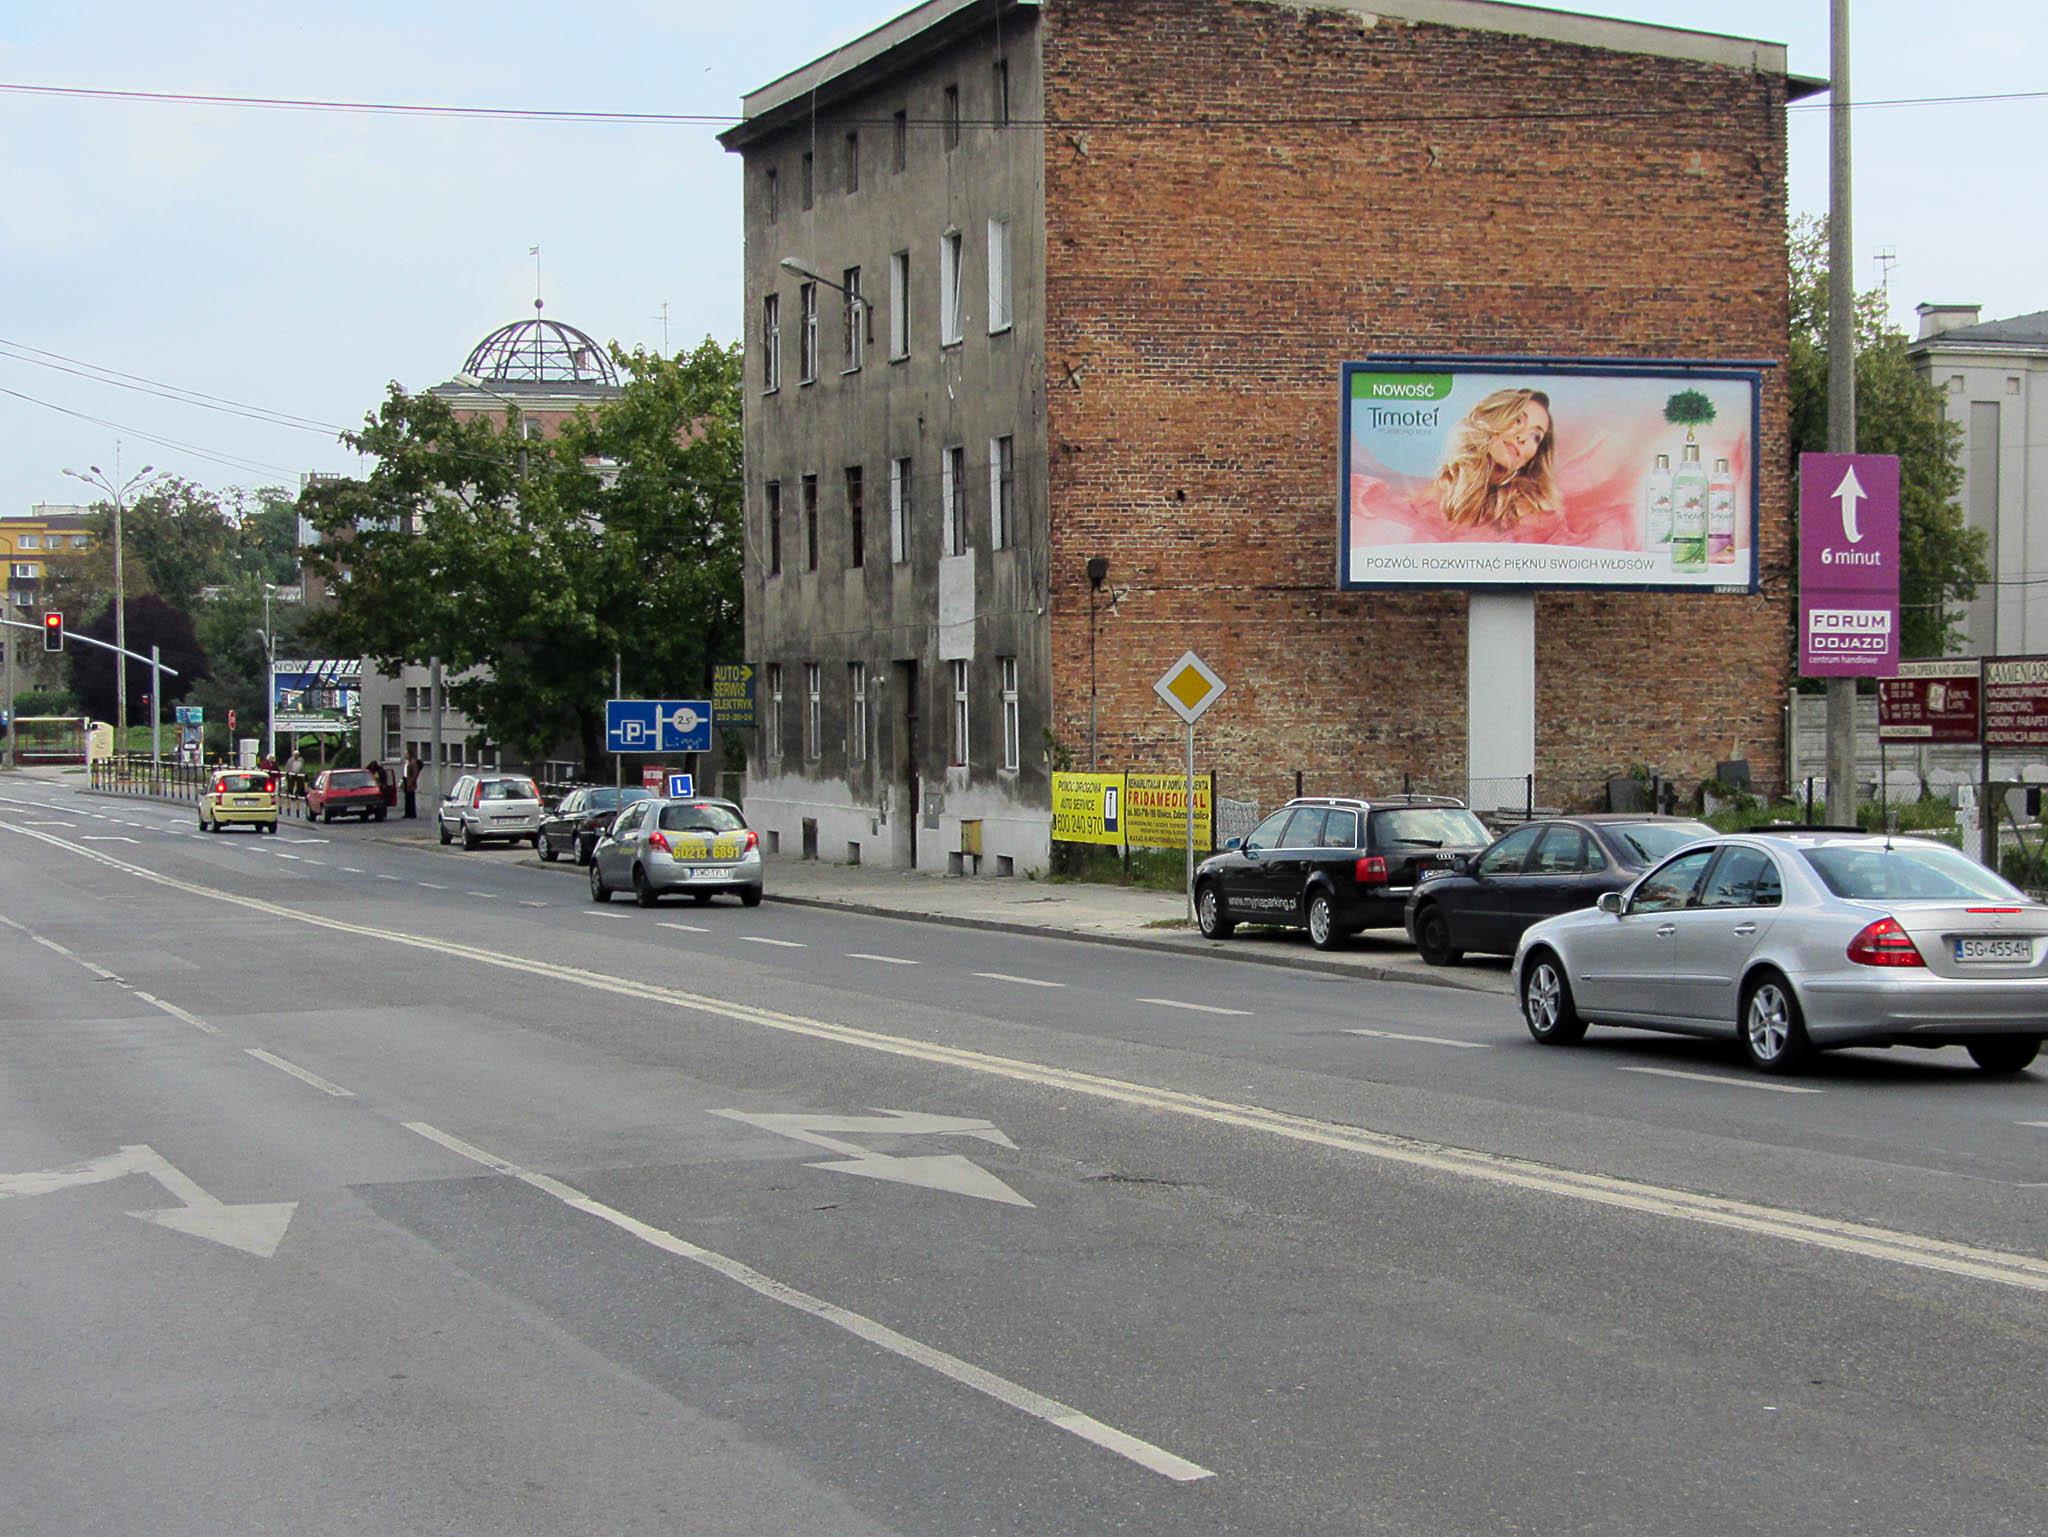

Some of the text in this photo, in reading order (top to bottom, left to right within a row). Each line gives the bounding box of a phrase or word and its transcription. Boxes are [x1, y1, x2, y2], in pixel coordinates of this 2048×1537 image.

[1373, 382, 1435, 397] NOWOŚĆ
[1367, 407, 1440, 429] Timotei
[1366, 557, 1655, 571] POZWÓL ROZKWITNĄĆ PIĘKNU SWOICH WŁOSÓW
[1821, 548, 1881, 565] 6 minut
[1813, 614, 1886, 629] FORUM
[1814, 636, 1884, 650] DOJAZD
[1808, 655, 1840, 664] centrum
[714, 665, 740, 681] AUTO
[713, 683, 747, 698] SERWIS
[713, 698, 753, 710] ELEKTRYK
[626, 723, 641, 742] P
[676, 779, 688, 794] L
[1060, 798, 1095, 811] AUTO SERVICE
[1127, 791, 1207, 808] FRIDAMEDICAL
[1057, 814, 1103, 835] 600 240 970
[1964, 941, 2030, 957] SG 4554H
